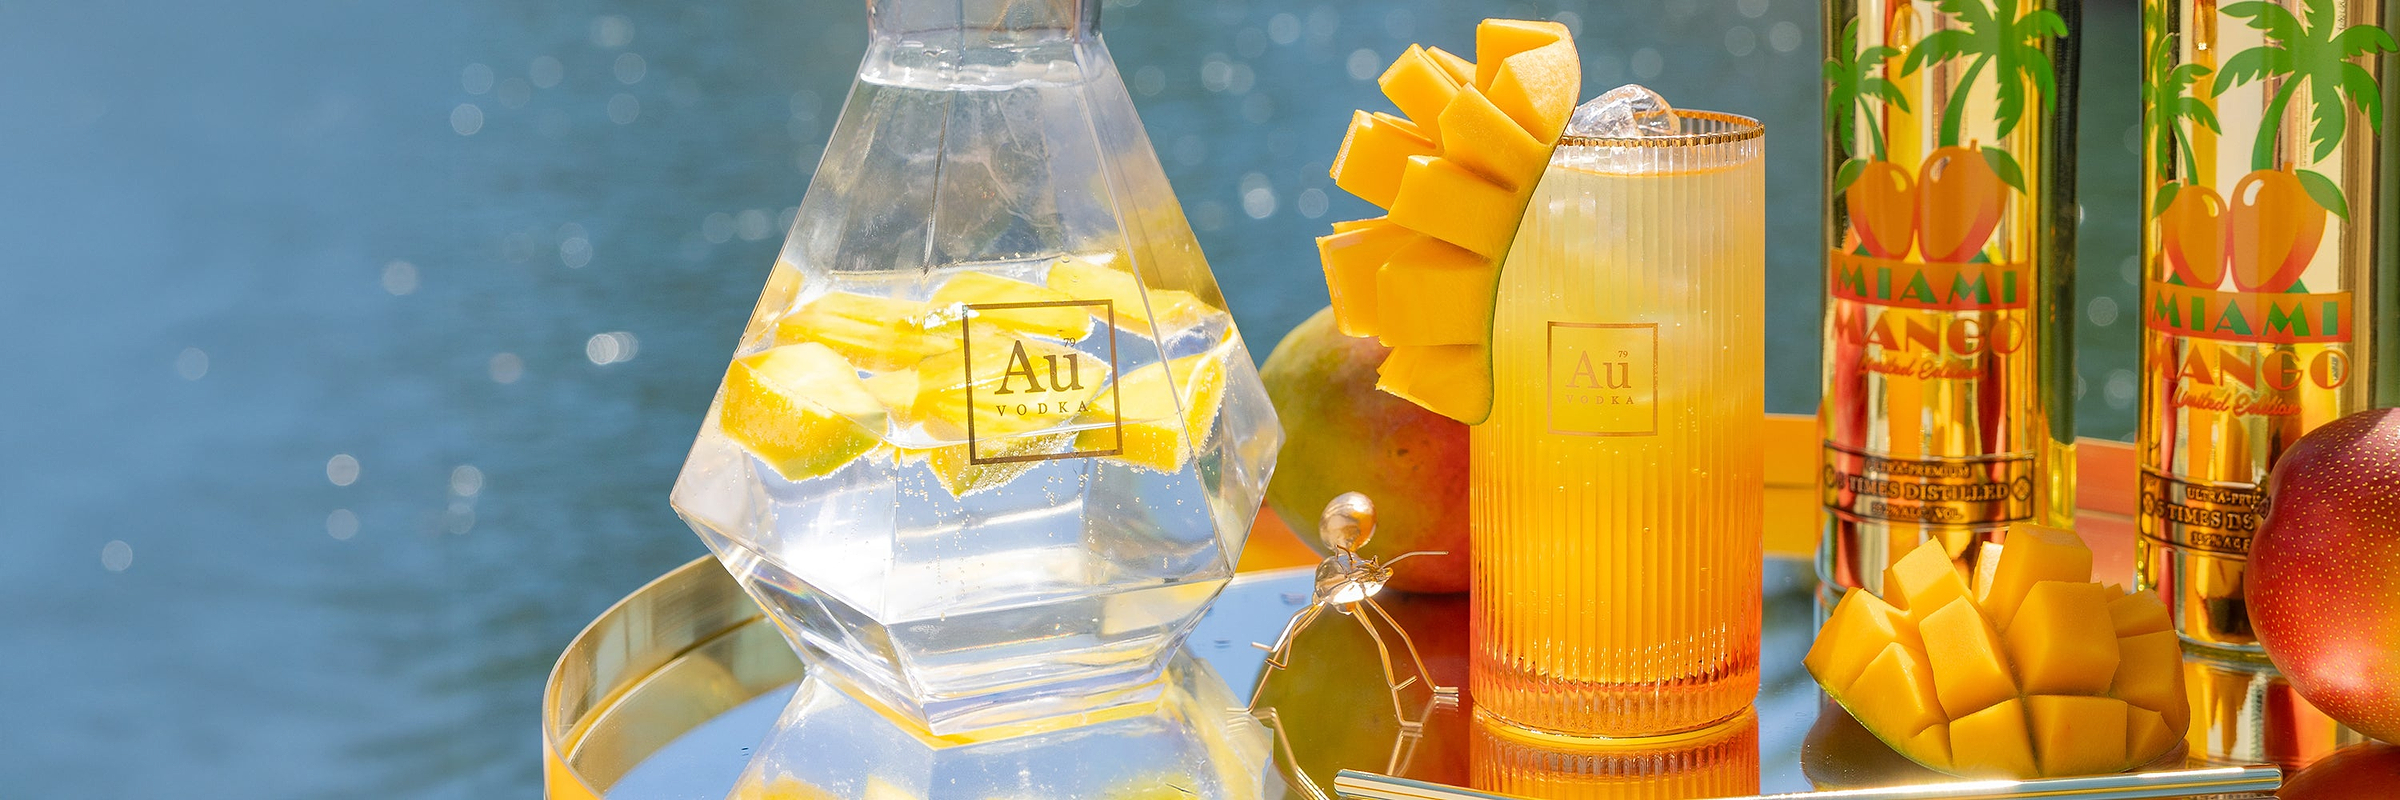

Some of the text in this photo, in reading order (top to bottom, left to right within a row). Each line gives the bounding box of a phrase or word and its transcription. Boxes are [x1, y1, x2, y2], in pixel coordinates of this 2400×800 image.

[1837, 261, 2017, 305] MIAMI
[1834, 307, 2025, 356] MANGO
[2152, 289, 2339, 337] MIAMI
[1063, 337, 1076, 348] 79
[1618, 350, 1629, 358] 79
[994, 340, 1085, 395] Au
[1565, 350, 1632, 389] Au
[2148, 338, 2350, 392] MANGO
[996, 400, 1089, 417] VODKA
[1566, 394, 1635, 405] VODKA
[2232, 393, 2302, 417] Edition
